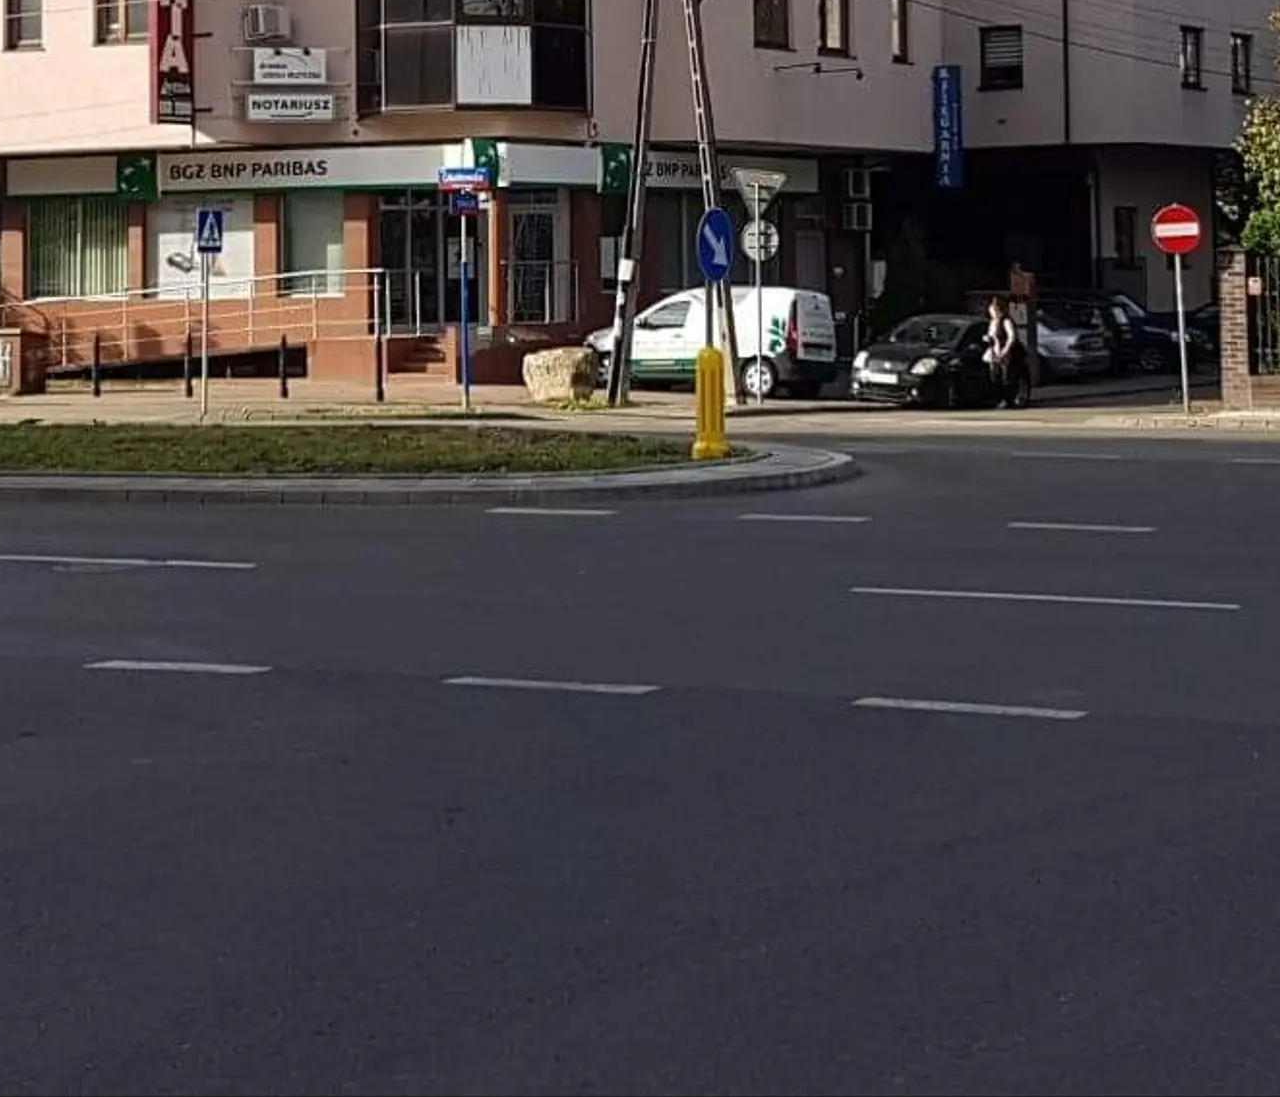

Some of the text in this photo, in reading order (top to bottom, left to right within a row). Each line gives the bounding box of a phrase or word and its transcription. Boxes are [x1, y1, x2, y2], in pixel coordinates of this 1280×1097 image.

[251, 100, 330, 110] NOTARIUSZ
[210, 162, 247, 178] BNP
[251, 159, 328, 177] PARIBAS
